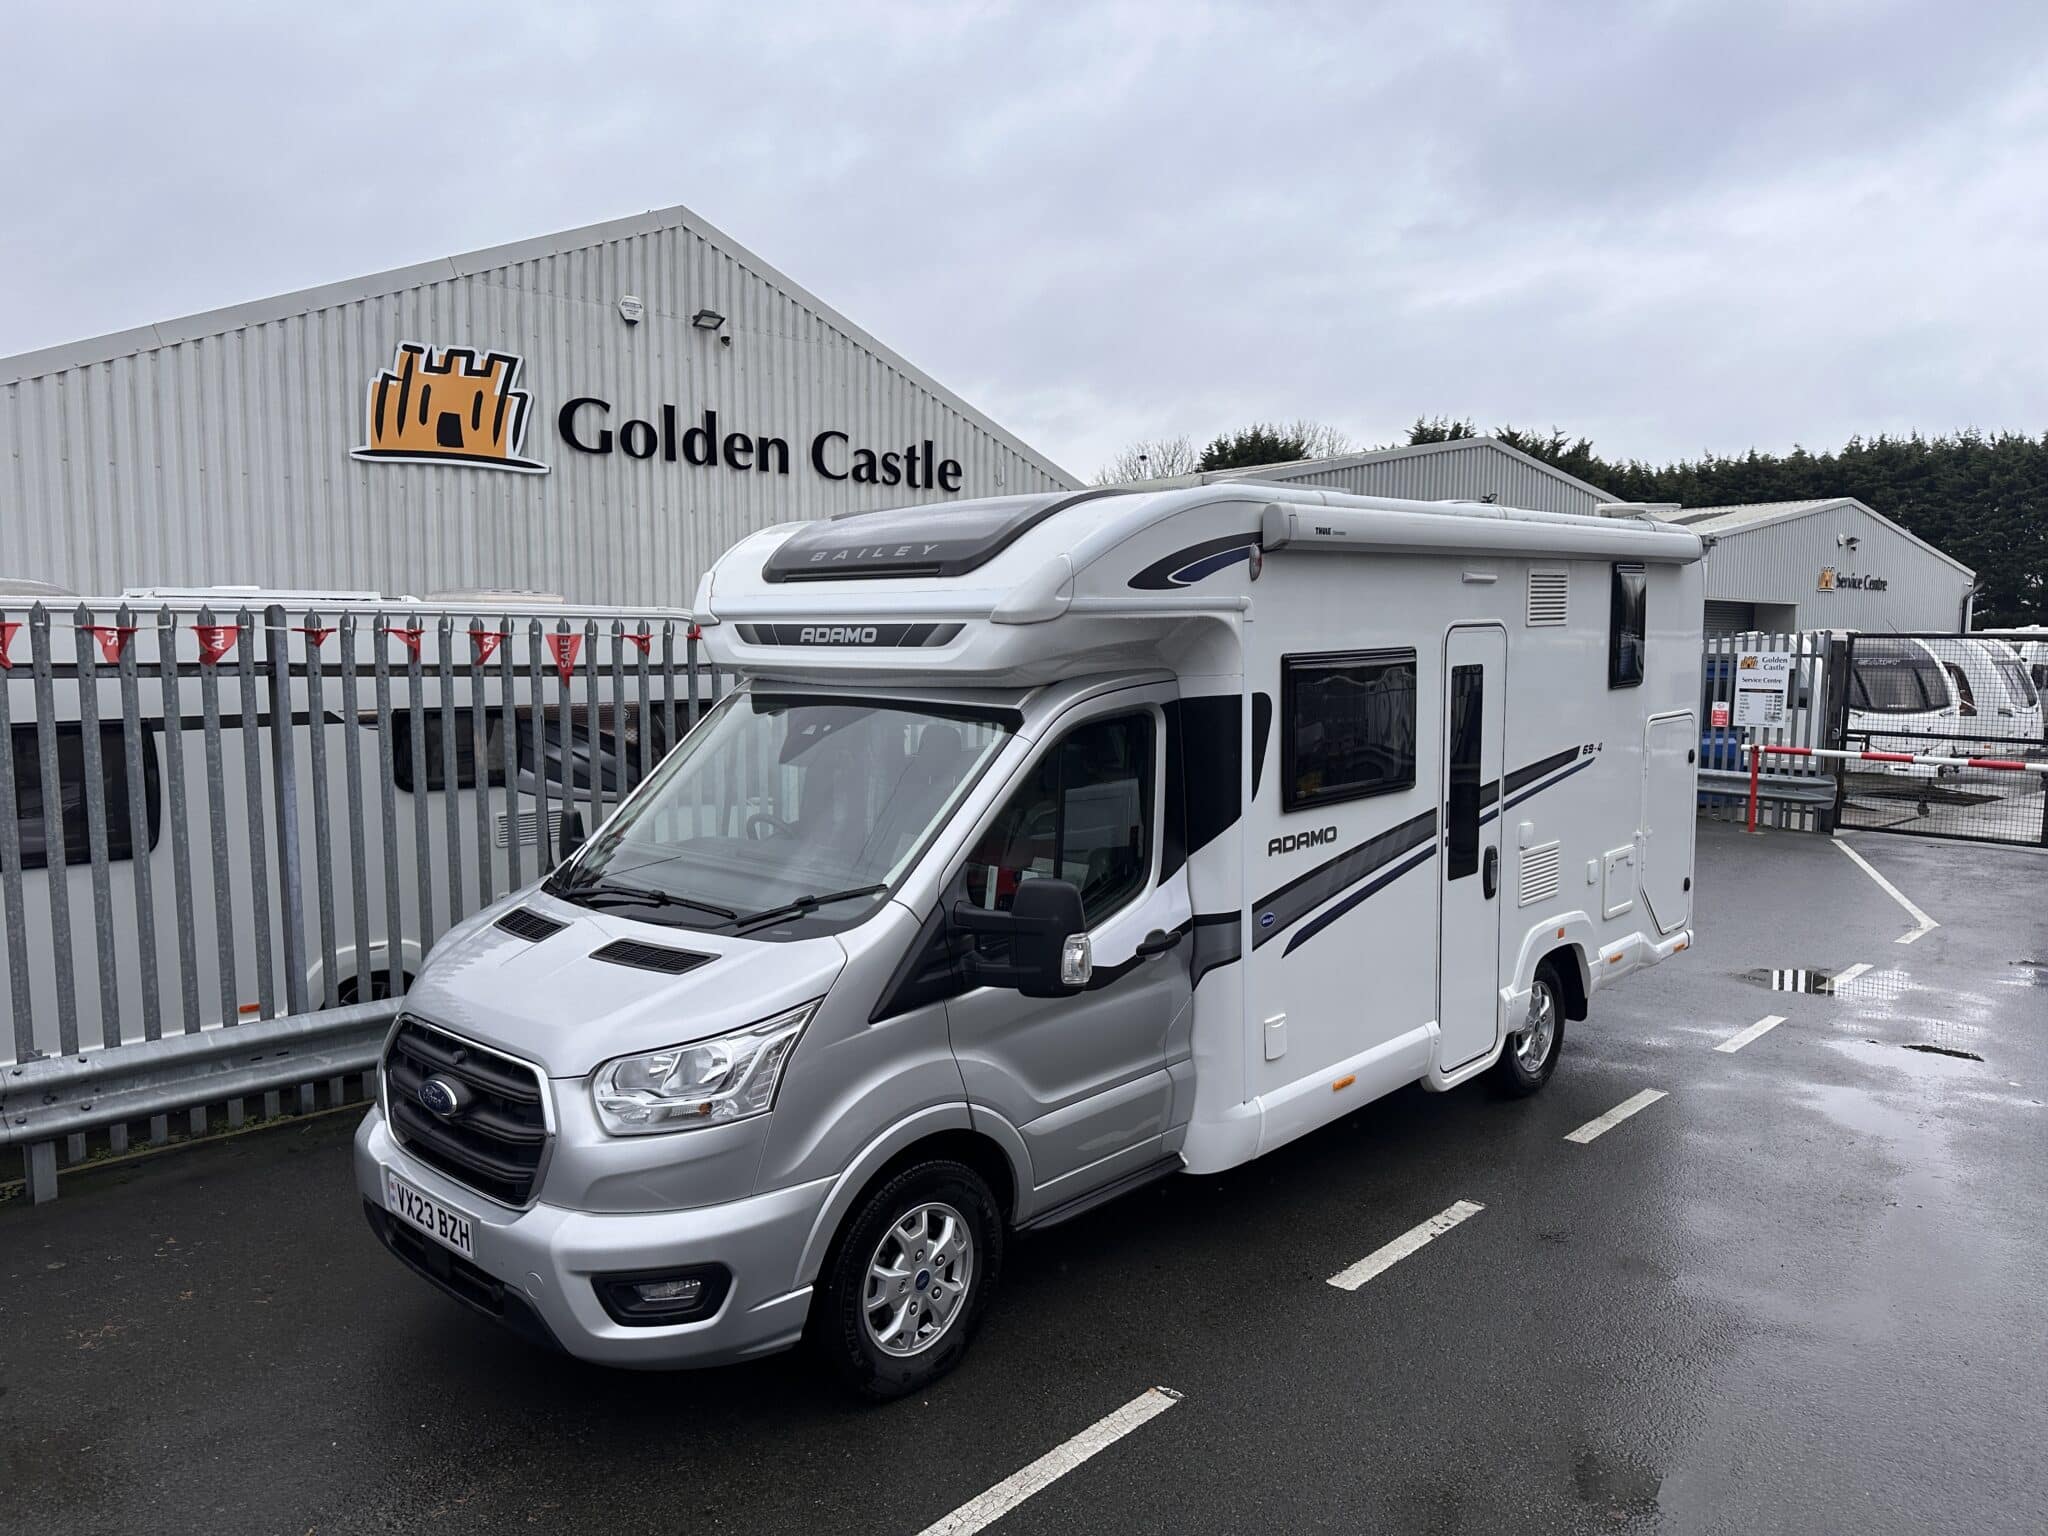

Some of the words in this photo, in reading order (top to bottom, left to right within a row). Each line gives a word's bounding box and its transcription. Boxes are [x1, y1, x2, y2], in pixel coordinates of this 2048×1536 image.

[559, 397, 789, 474] Golden
[811, 430, 963, 493] Castle
[810, 543, 939, 562] BAILEY
[1836, 572, 1863, 590] Service
[1863, 574, 1888, 591] Centre
[799, 626, 877, 644] ADAMO
[560, 639, 571, 668] SALE
[1761, 656, 1788, 664] Golden
[1268, 825, 1338, 857] ADAMO
[396, 1182, 435, 1231] VX23
[438, 1205, 471, 1253] BZH
